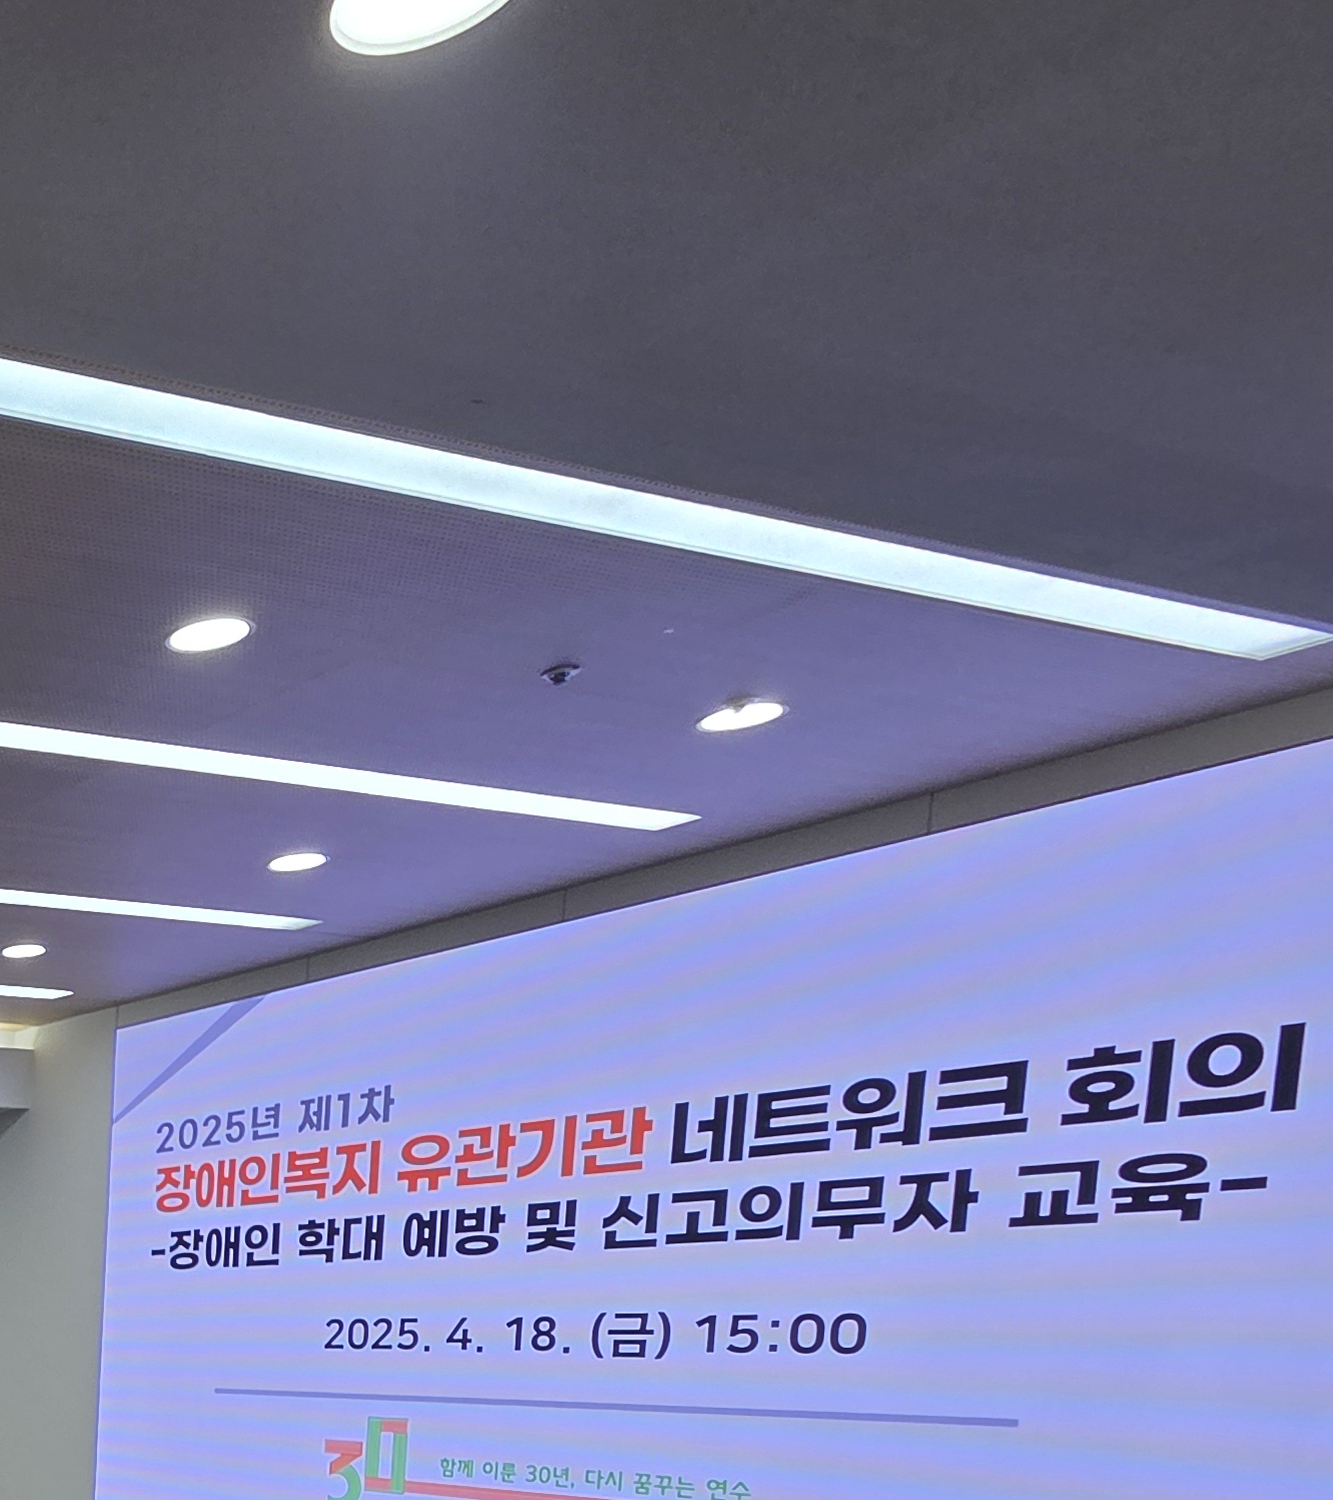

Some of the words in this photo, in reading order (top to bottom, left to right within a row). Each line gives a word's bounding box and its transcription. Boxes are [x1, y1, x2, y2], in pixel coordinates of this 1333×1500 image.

[155, 1140, 383, 1213] 장애인복지
[396, 1106, 653, 1194] 유관기관
[671, 1059, 1029, 1164] 네트워크
[1060, 1022, 1306, 1126] 회의
[155, 1102, 281, 1154] 2025년
[298, 1084, 395, 1135] 제1차
[297, 1214, 386, 1263] 학대
[402, 1206, 506, 1258] 예방
[525, 1200, 577, 1252] 및
[602, 1168, 979, 1250] 신고의무자
[324, 1318, 431, 1352] 2025.
[445, 1317, 484, 1353] 4.
[505, 1316, 571, 1354] 18.
[591, 1312, 671, 1360] (금)
[695, 1313, 868, 1355] 15:00
[440, 1458, 474, 1478] 함께
[483, 1462, 517, 1484] 이룬
[526, 1465, 575, 1490] 30년,
[584, 1469, 623, 1491] 다시
[633, 1472, 695, 1500] 꿈꾸는
